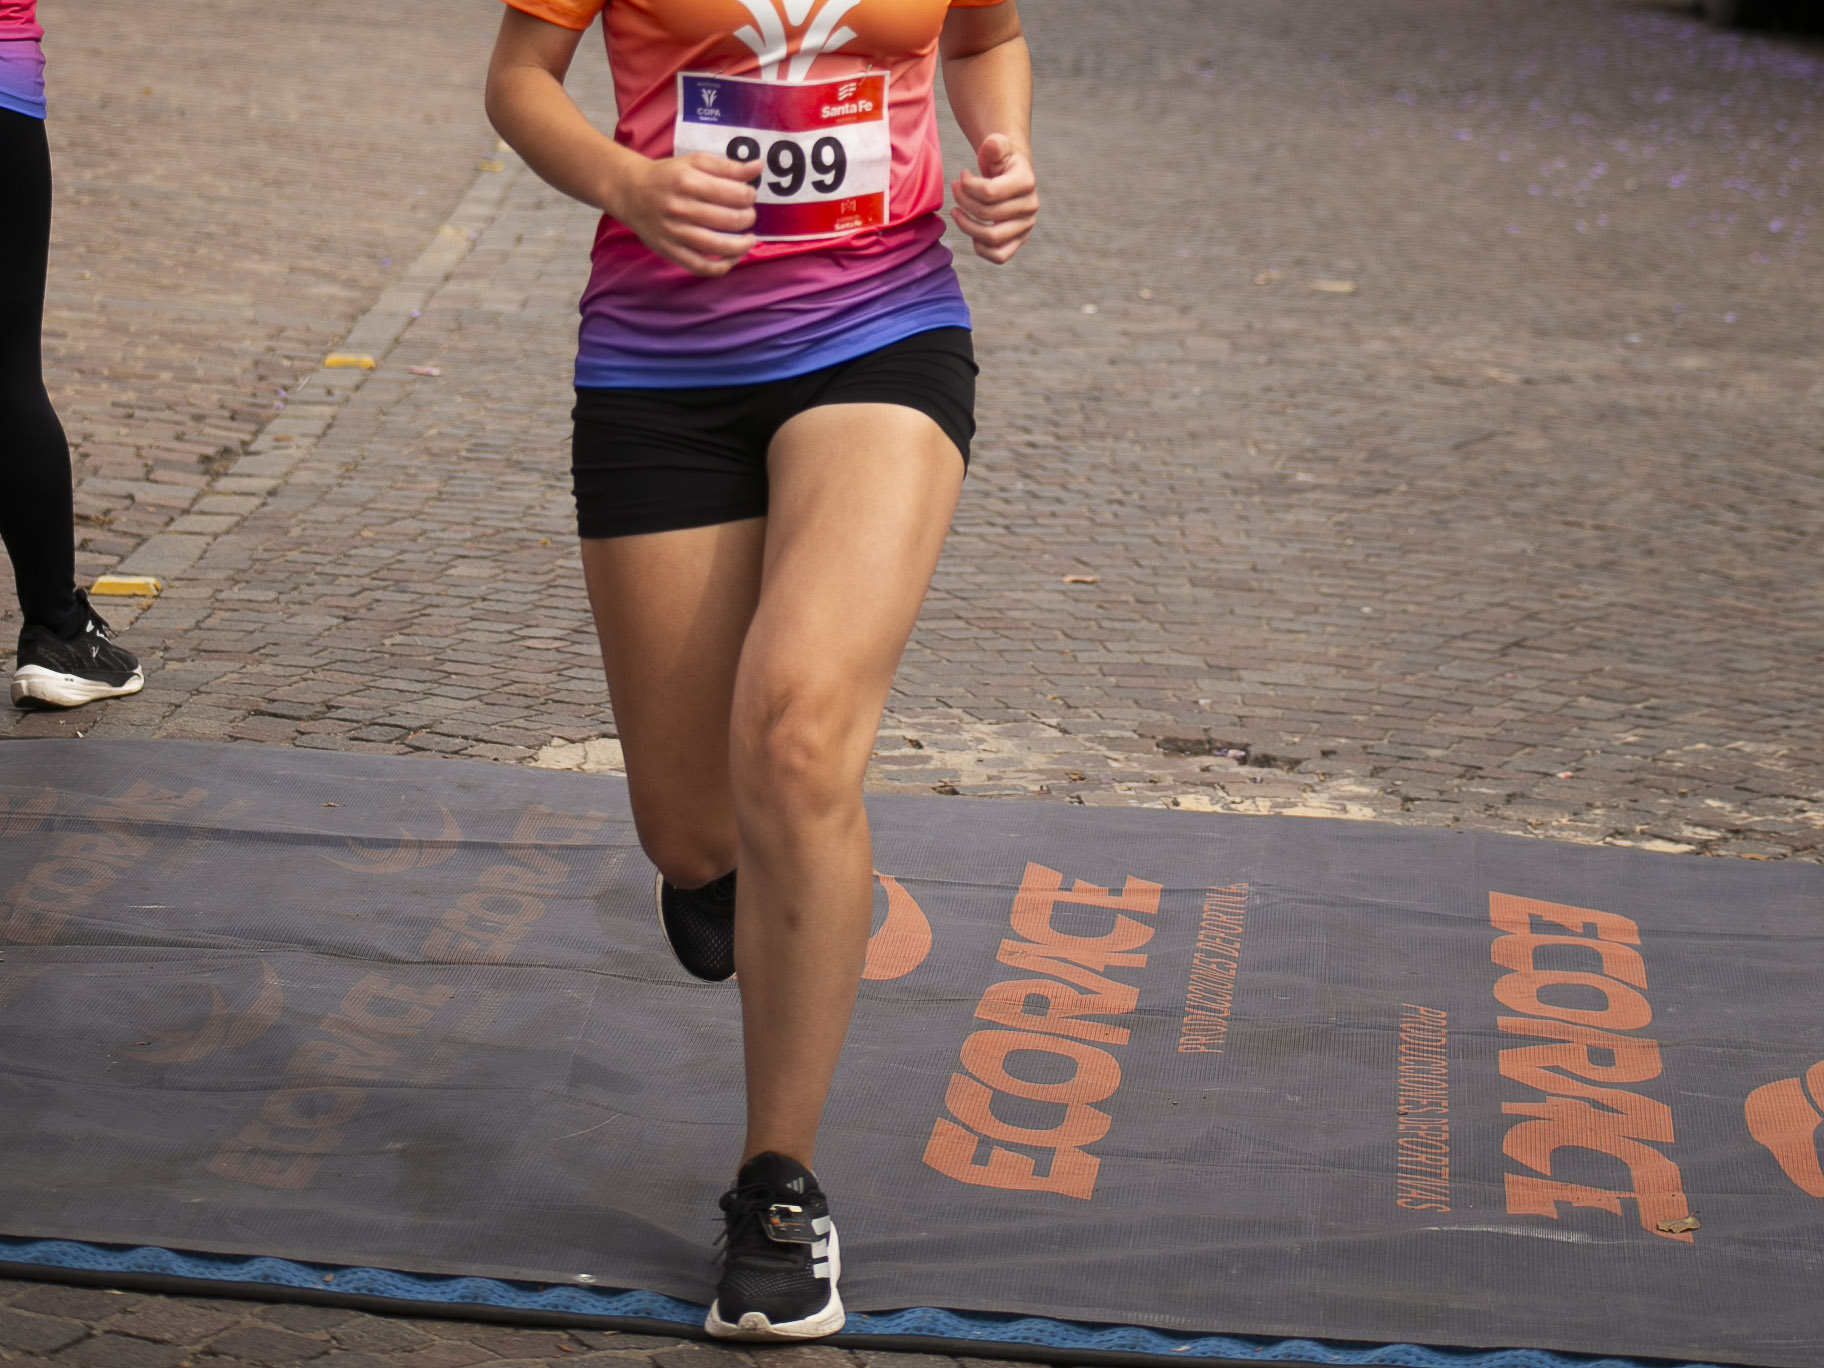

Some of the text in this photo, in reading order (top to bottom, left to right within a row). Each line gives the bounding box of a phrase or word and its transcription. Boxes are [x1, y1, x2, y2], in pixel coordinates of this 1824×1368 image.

[697, 107, 721, 117] COPA
[821, 99, 873, 119] Santa Fe
[922, 861, 1163, 1200] ECORACE
[1396, 1003, 1451, 1213] PRODUCCIONES DEPORTIVAS
[1487, 890, 1694, 1243] ECORACE
